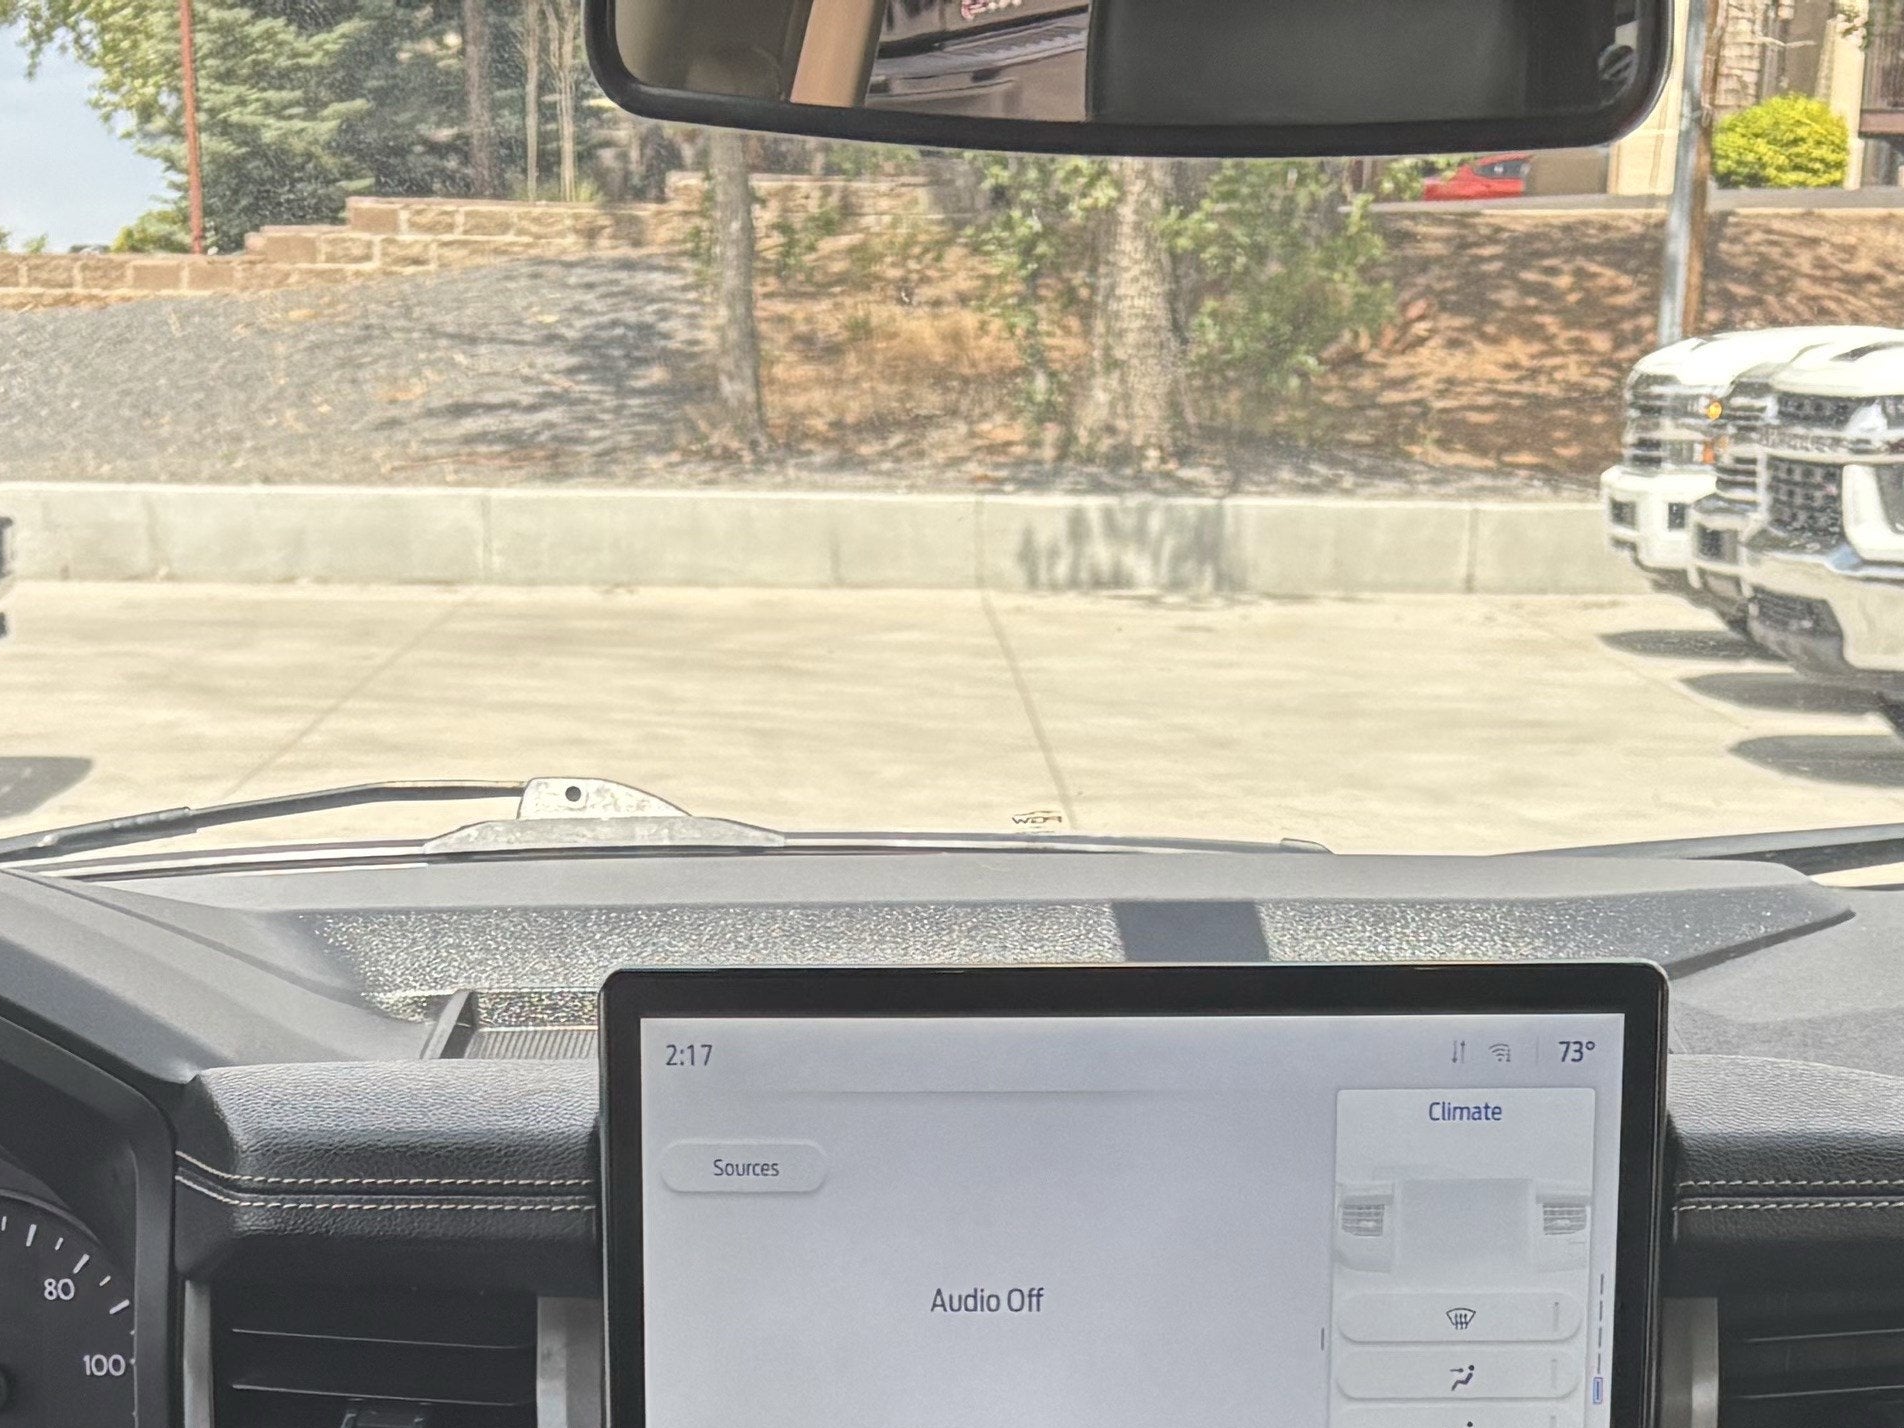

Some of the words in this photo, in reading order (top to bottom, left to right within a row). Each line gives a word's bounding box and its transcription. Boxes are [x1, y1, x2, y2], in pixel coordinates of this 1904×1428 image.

[665, 1043, 714, 1067] 2:17
[1557, 1040, 1597, 1063] 73°
[1428, 1101, 1503, 1122] Climate
[713, 1158, 780, 1177] Sources
[44, 1278, 75, 1301] 80
[930, 1287, 1001, 1313] Audio
[1007, 1287, 1045, 1313] Off
[83, 1354, 126, 1377] 100
